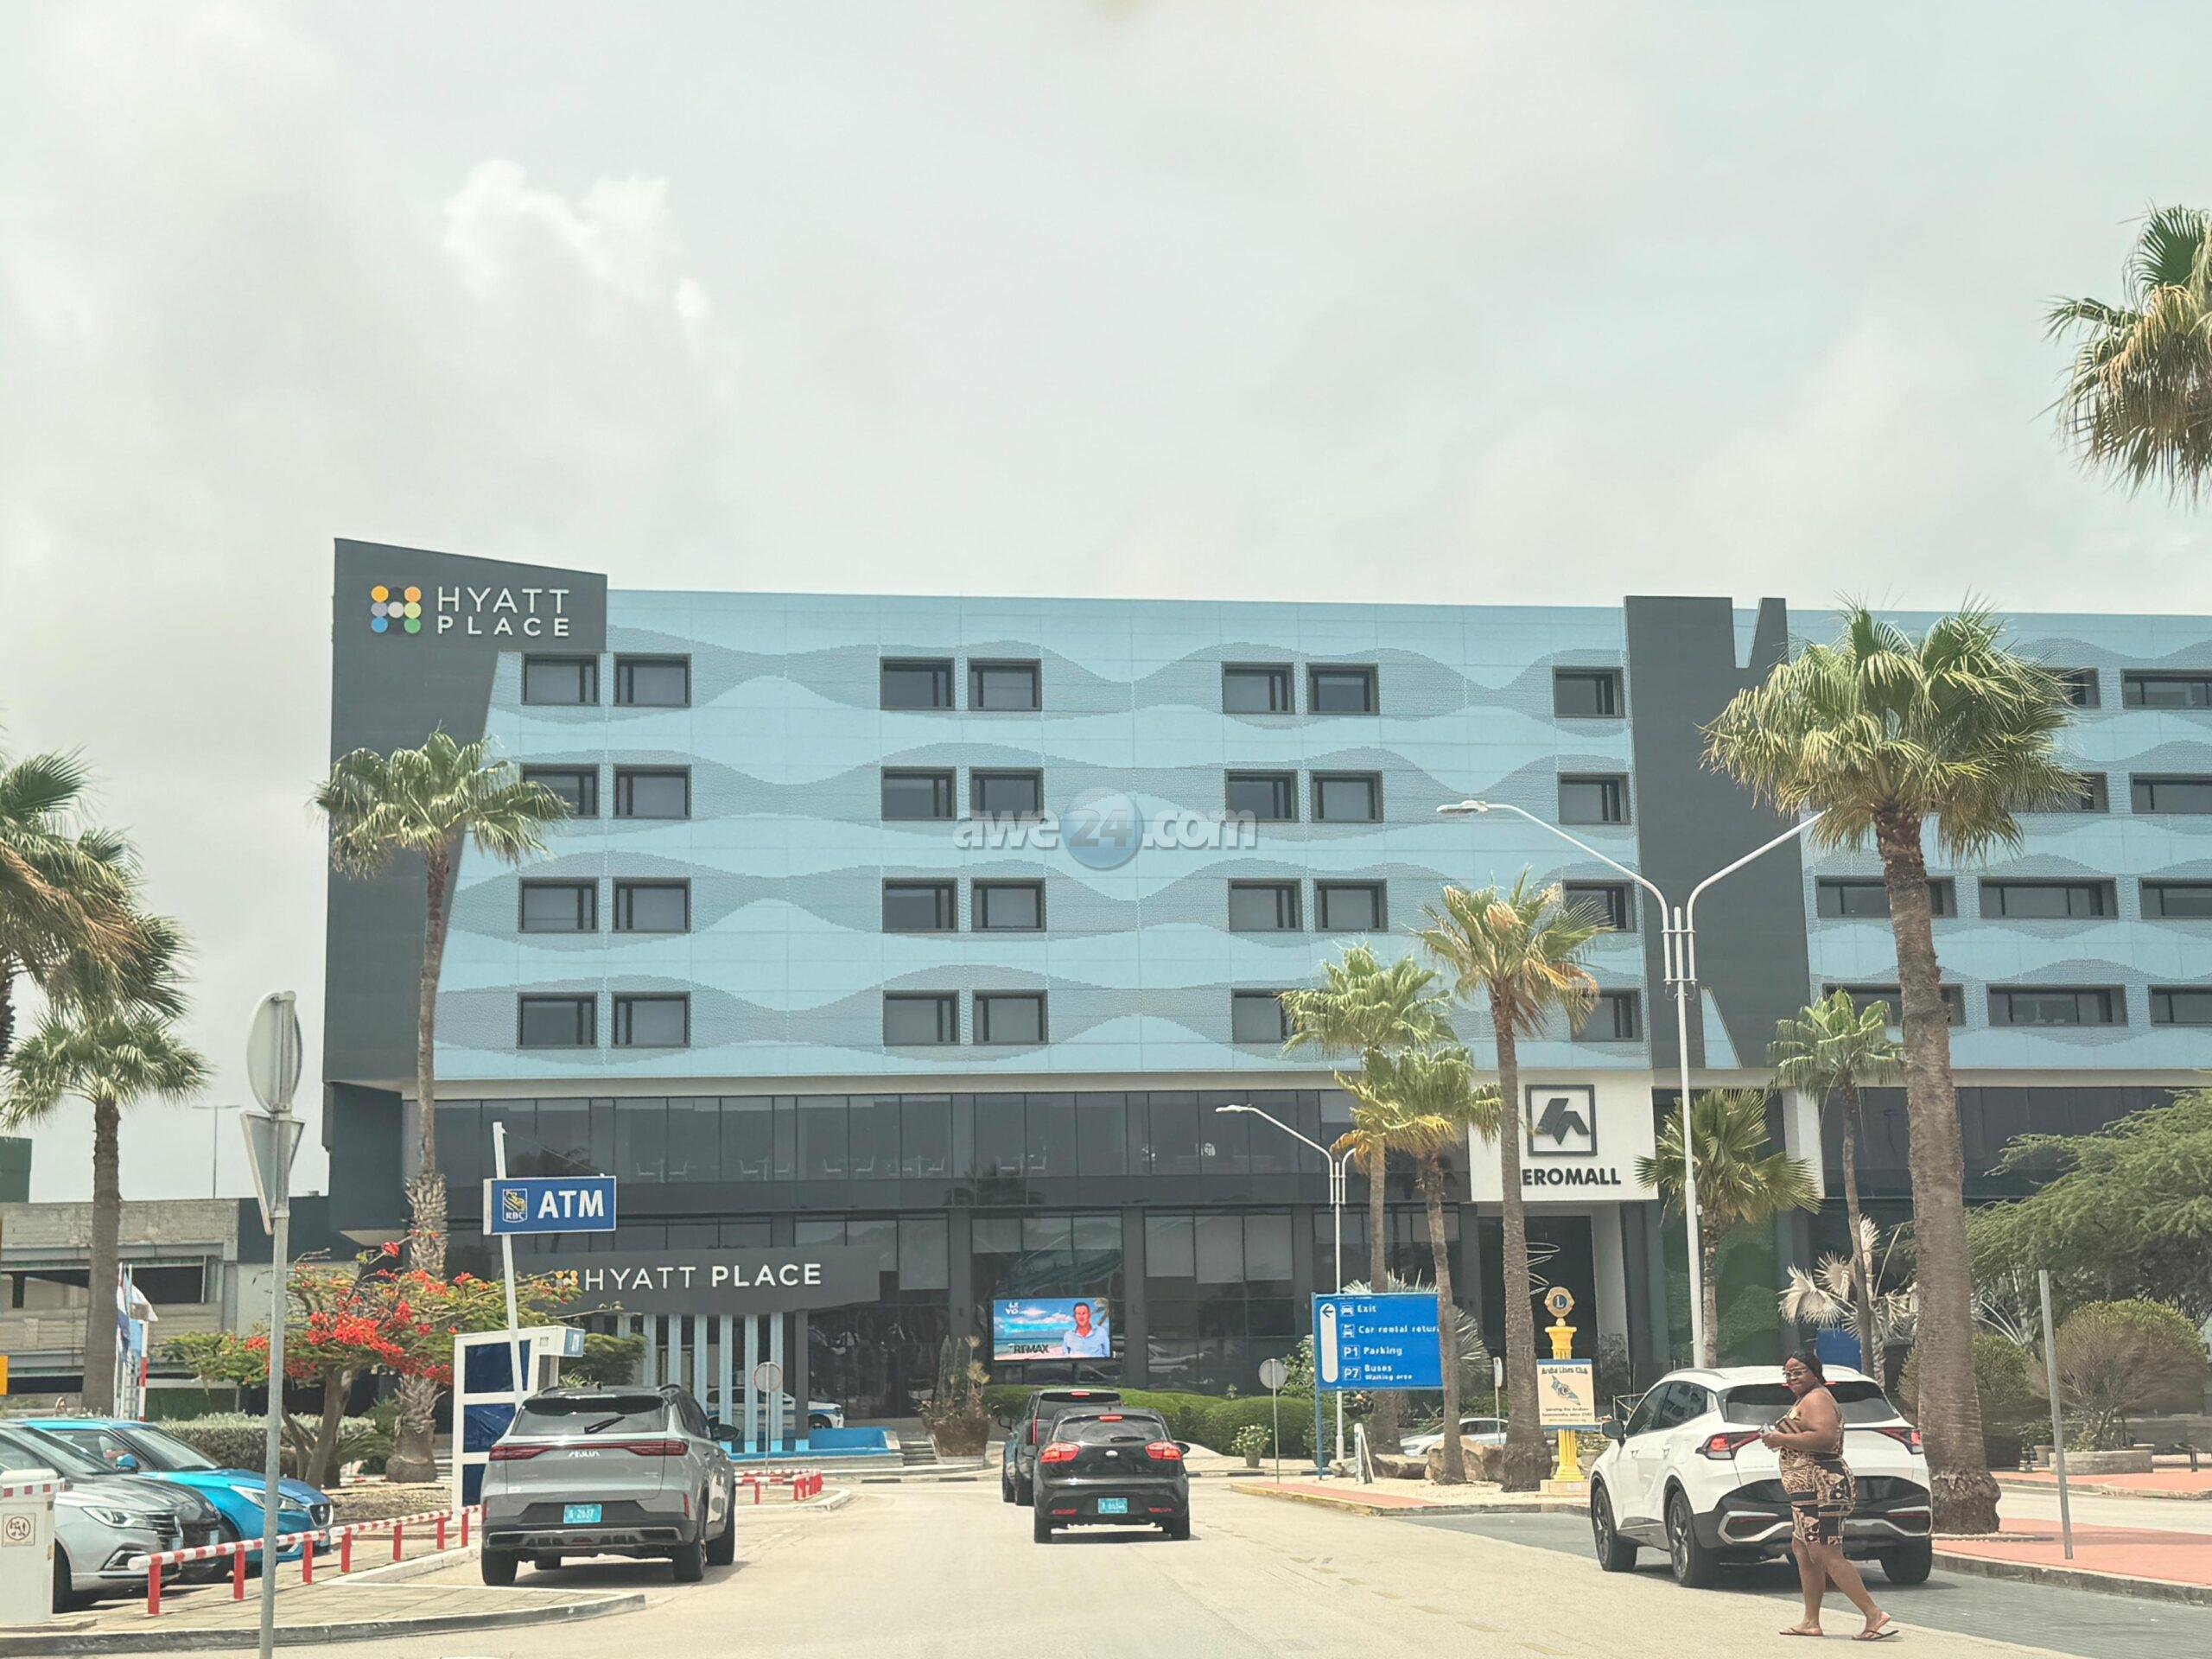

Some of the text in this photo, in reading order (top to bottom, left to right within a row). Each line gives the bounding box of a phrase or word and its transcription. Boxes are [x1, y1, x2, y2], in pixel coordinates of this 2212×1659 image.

[437, 586, 570, 613] HYATT
[437, 615, 570, 637] PLACE
[1522, 1167, 1622, 1186] EROMALL
[537, 1190, 604, 1219] ATM
[584, 1263, 822, 1292] HYATT PLACE
[1378, 1325, 1408, 1333] rental
[1344, 1346, 1402, 1357] P1 Parking
[1344, 1368, 1359, 1378] P7
